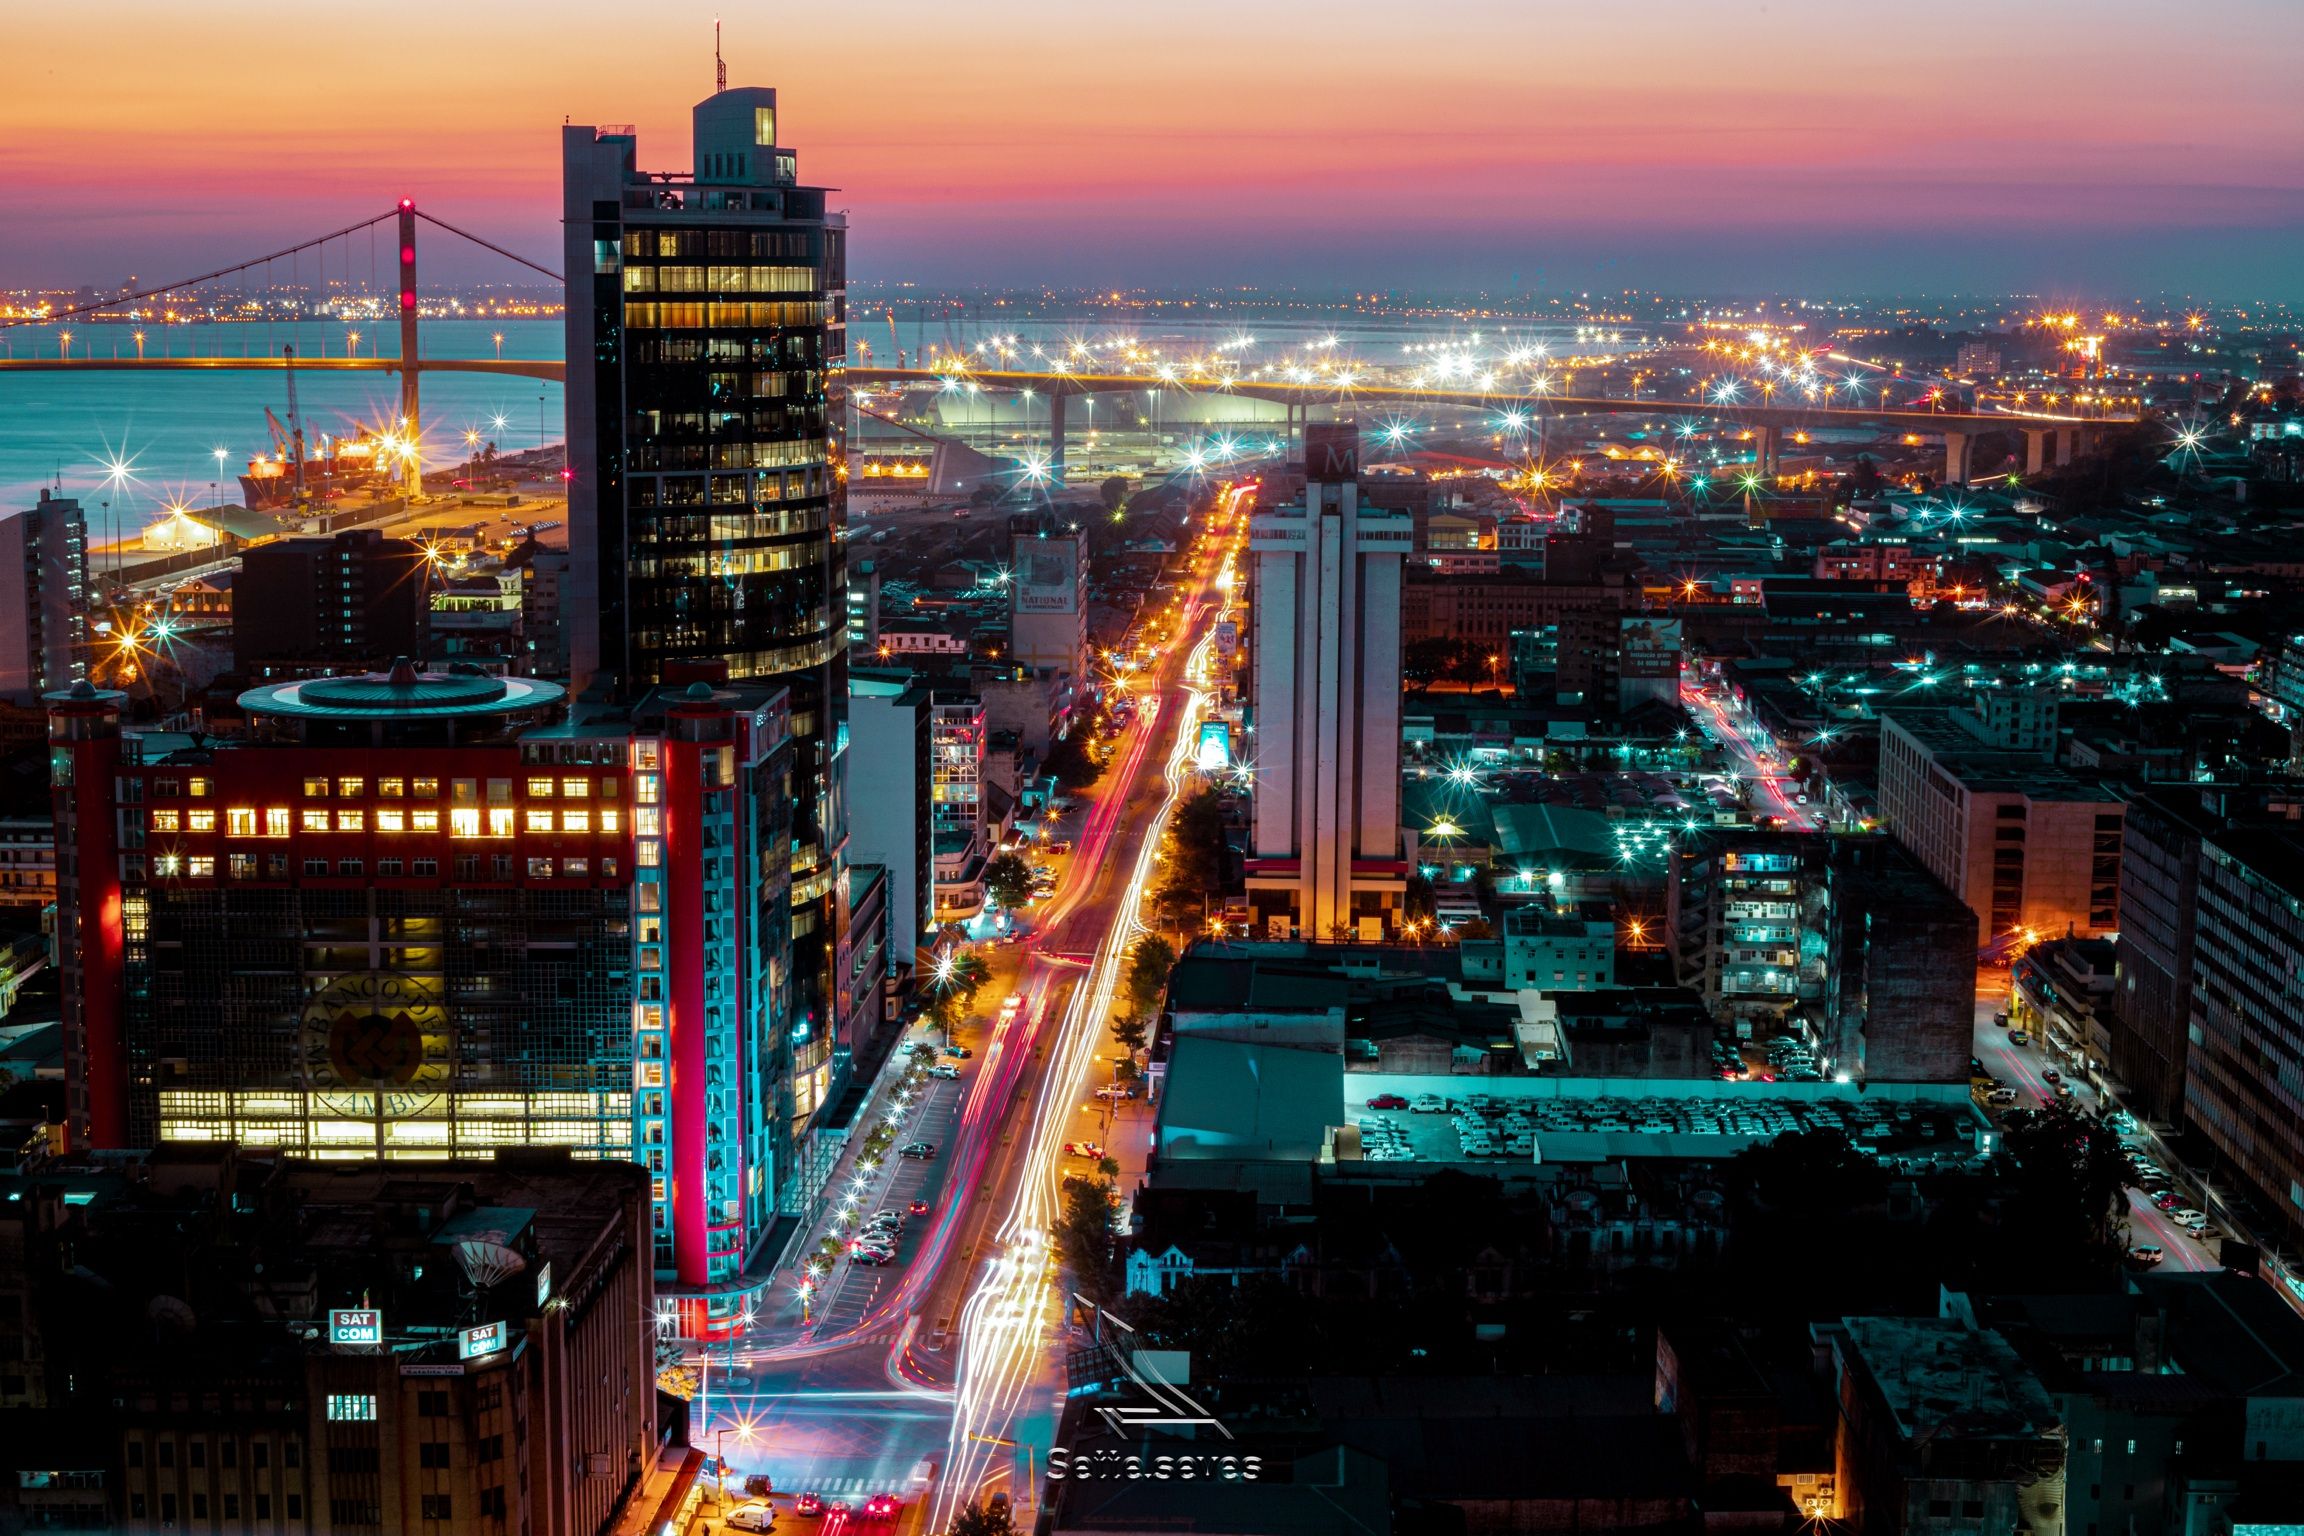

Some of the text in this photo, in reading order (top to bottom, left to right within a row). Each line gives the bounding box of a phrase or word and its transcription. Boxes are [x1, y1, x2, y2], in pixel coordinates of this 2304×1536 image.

[308, 977, 400, 1034] BANCO
[408, 995, 443, 1033] DE
[340, 1313, 370, 1325] SAT
[338, 1328, 374, 1340] COM
[472, 1327, 494, 1341] SAT
[470, 1338, 496, 1354] COM
